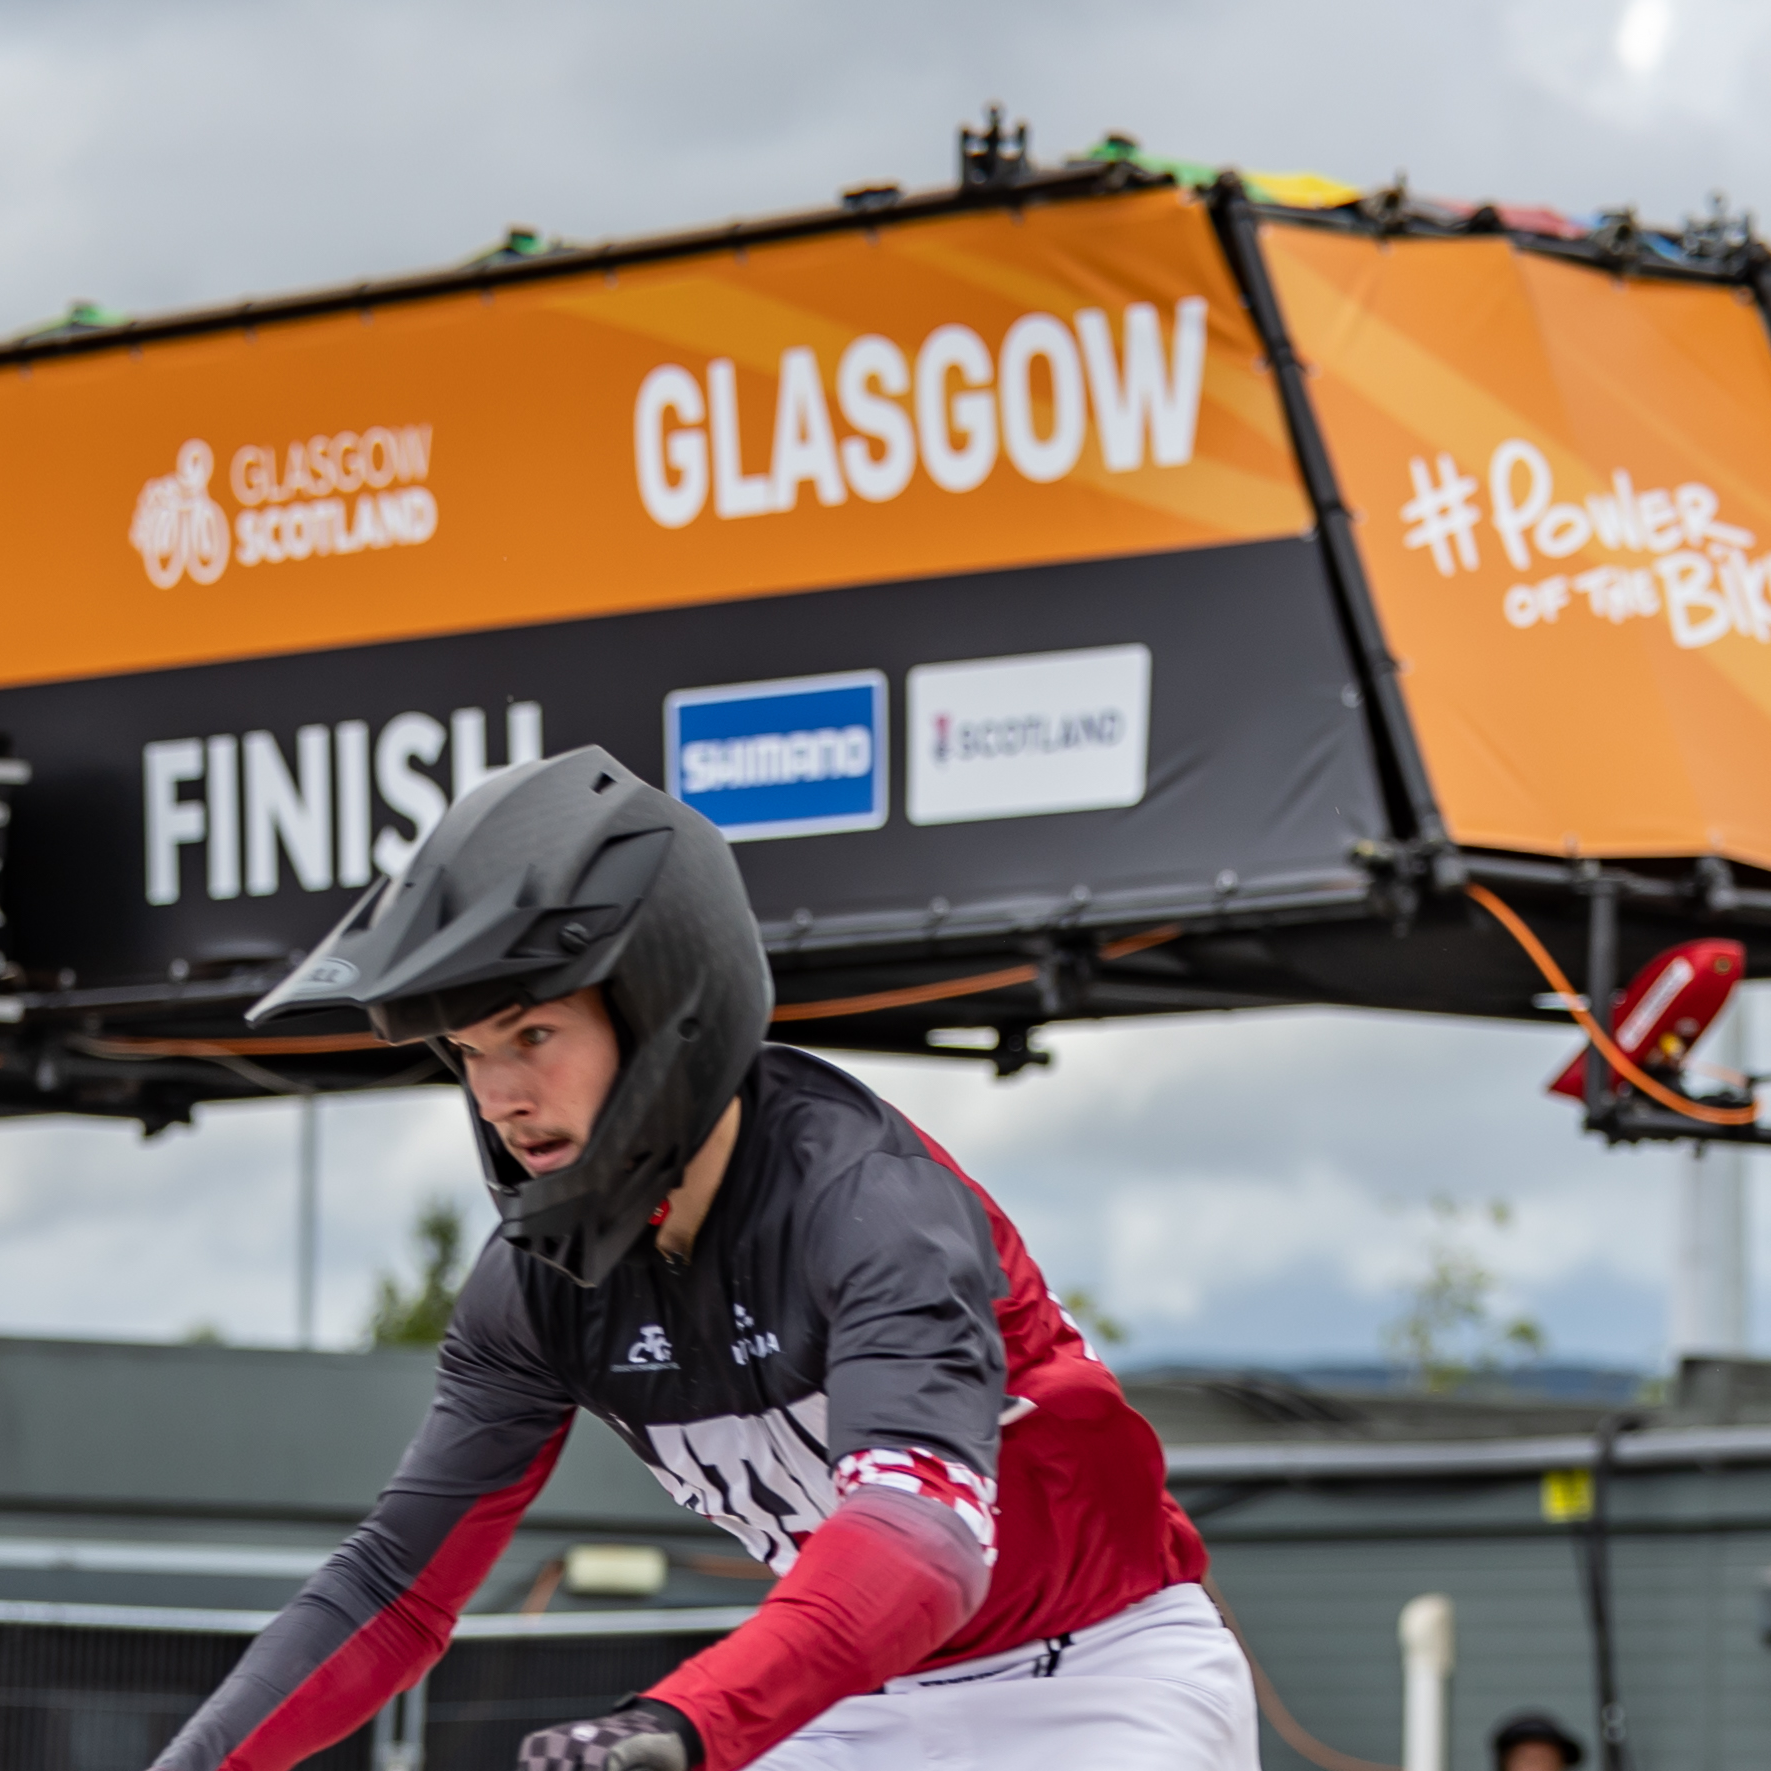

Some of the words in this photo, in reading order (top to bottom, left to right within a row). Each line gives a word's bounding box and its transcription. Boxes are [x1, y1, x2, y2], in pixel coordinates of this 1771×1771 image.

[634, 297, 1208, 529] GLASGOW
[229, 424, 435, 511] GLASGOW
[233, 486, 438, 567] SCOTLAND
[1504, 577, 1571, 628] OF
[679, 724, 873, 796] SHIMANO
[954, 710, 1124, 765] SCOTLAND
